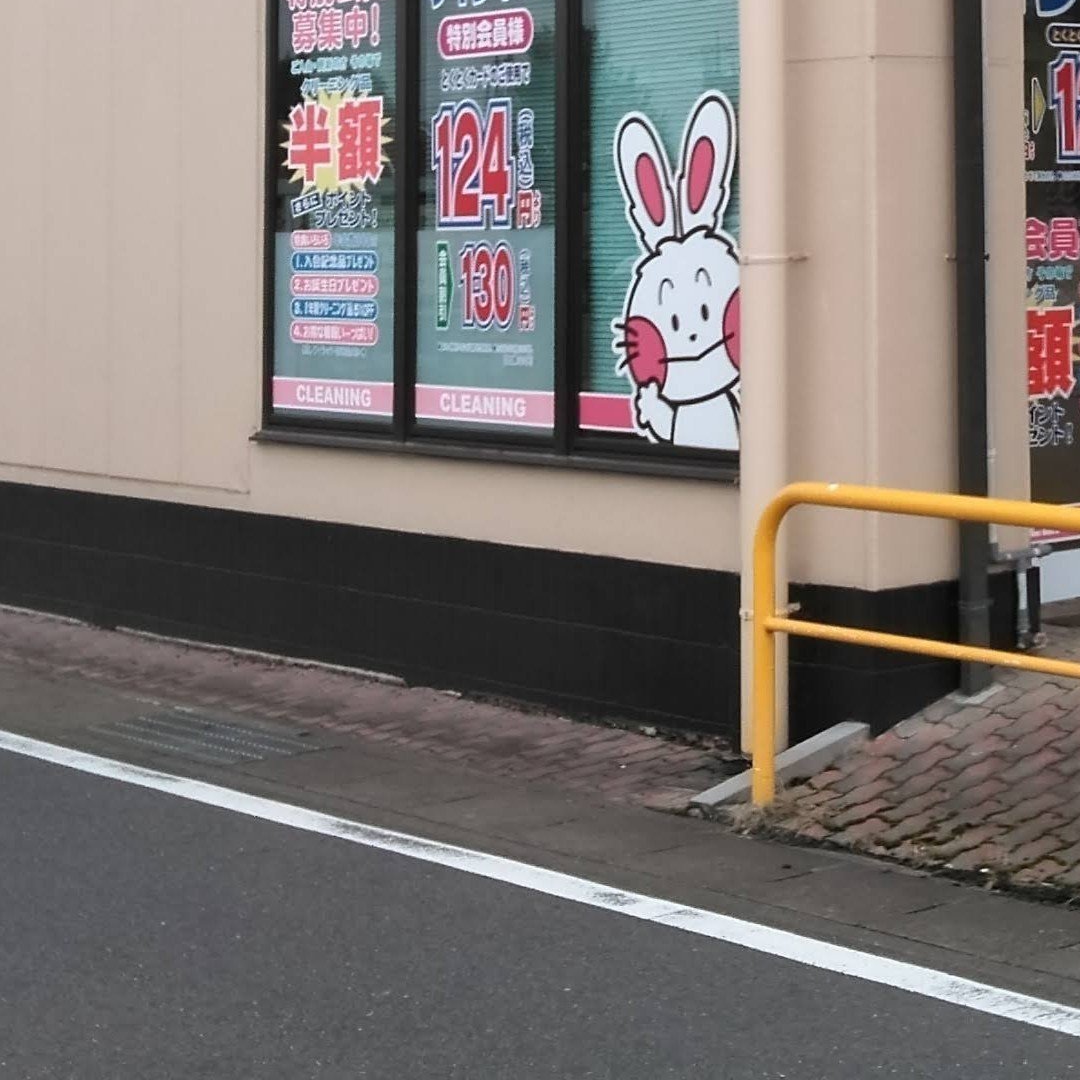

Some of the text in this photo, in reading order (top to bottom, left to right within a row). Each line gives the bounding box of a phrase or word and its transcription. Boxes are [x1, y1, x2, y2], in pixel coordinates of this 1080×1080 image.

[292, 3, 381, 53] 募集中!
[288, 96, 384, 184] 半額
[431, 98, 515, 230] 124
[457, 240, 515, 331] 130
[295, 383, 373, 408] CLEANING
[438, 392, 527, 418] CLEANING
